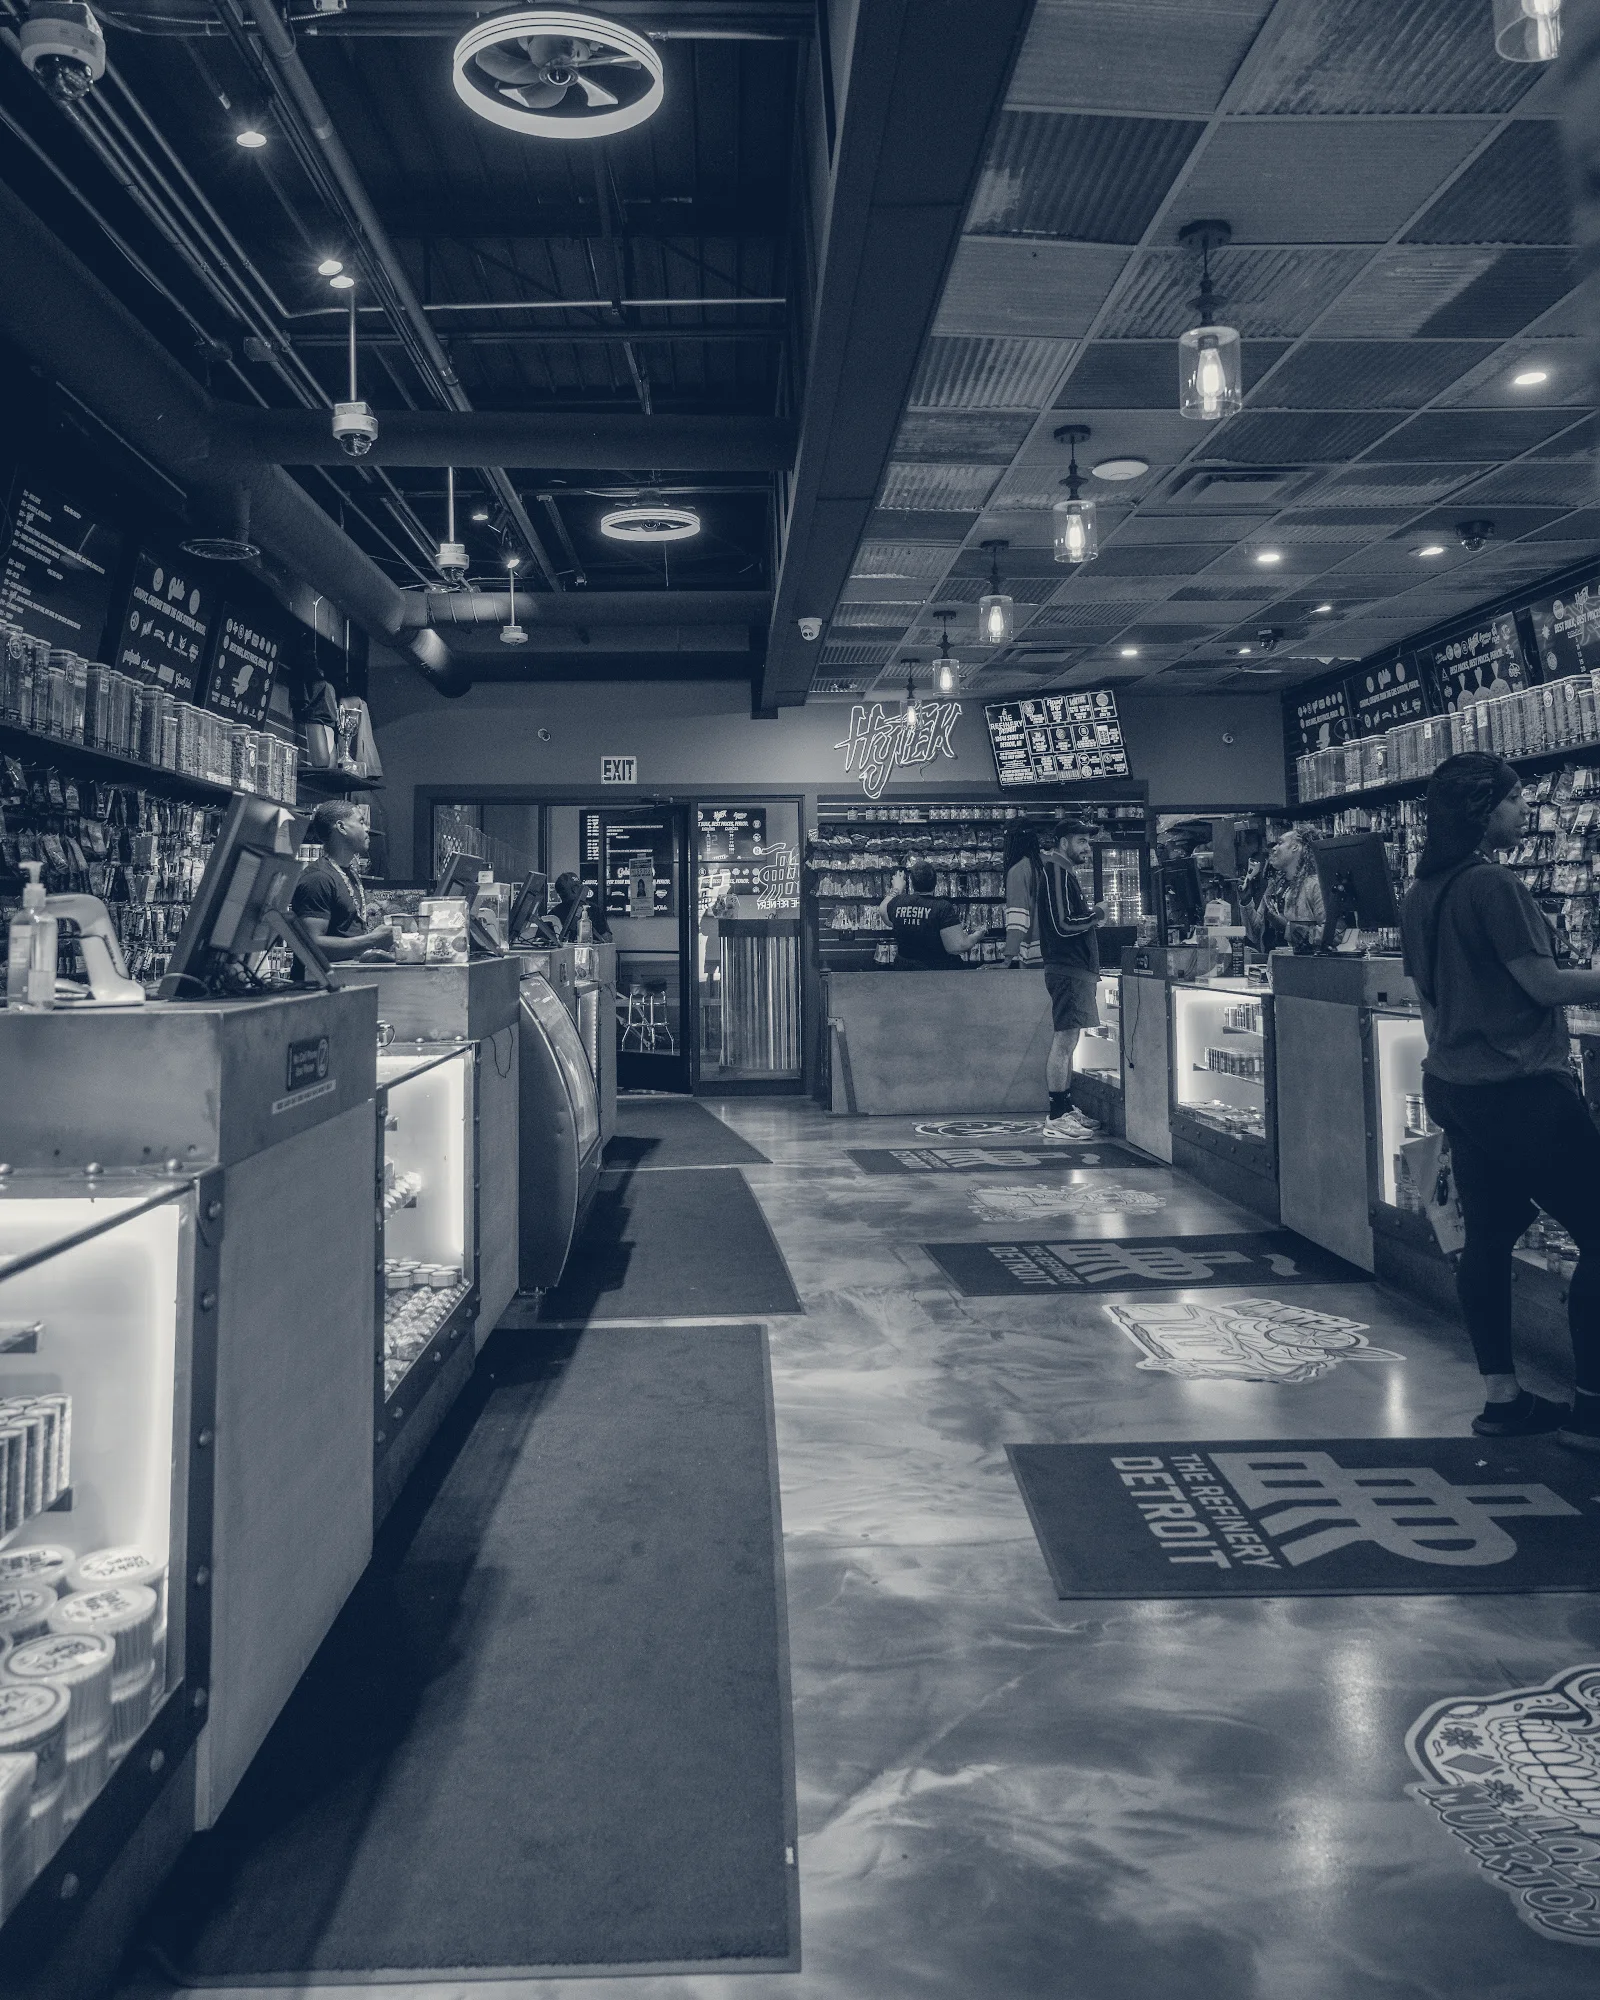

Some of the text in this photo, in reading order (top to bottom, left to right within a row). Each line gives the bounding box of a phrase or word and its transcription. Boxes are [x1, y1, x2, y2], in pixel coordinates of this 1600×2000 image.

[990, 720, 1023, 730] REFINERY
[998, 714, 1013, 722] THE
[603, 759, 635, 781] EXIT
[895, 905, 932, 920] FRESHY
[986, 1246, 1059, 1285] DETROIT
[1033, 1256, 1085, 1285] REFINERY
[1110, 1456, 1232, 1569] DETROIT
[1169, 1454, 1284, 1569] THE REFINERY
[1416, 1781, 1600, 1936] MUERTOS
